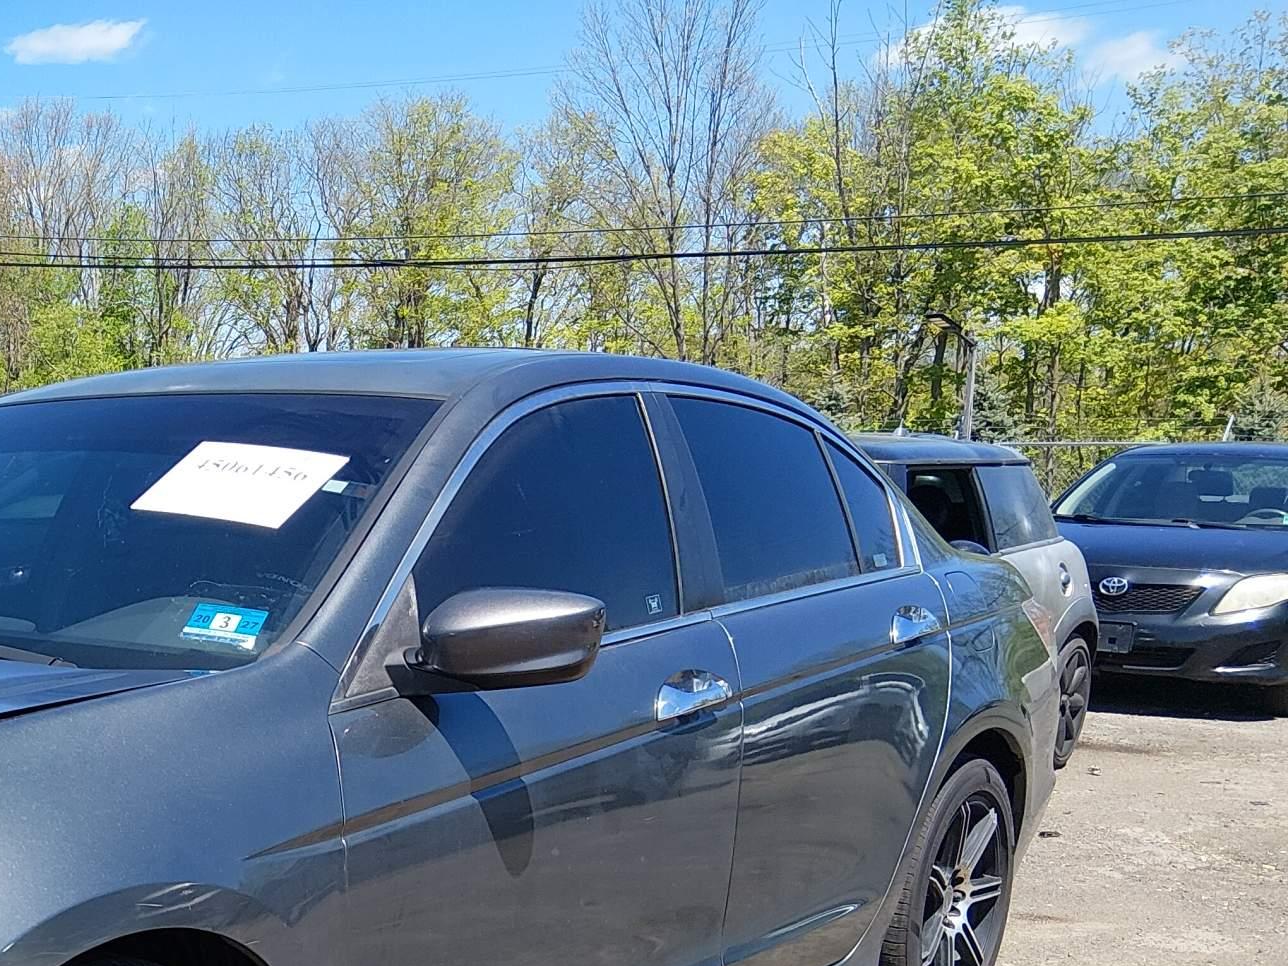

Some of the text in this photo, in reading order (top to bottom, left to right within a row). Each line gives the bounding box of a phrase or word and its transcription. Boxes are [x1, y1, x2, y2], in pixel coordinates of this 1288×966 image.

[192, 614, 260, 630] 20 3 27
